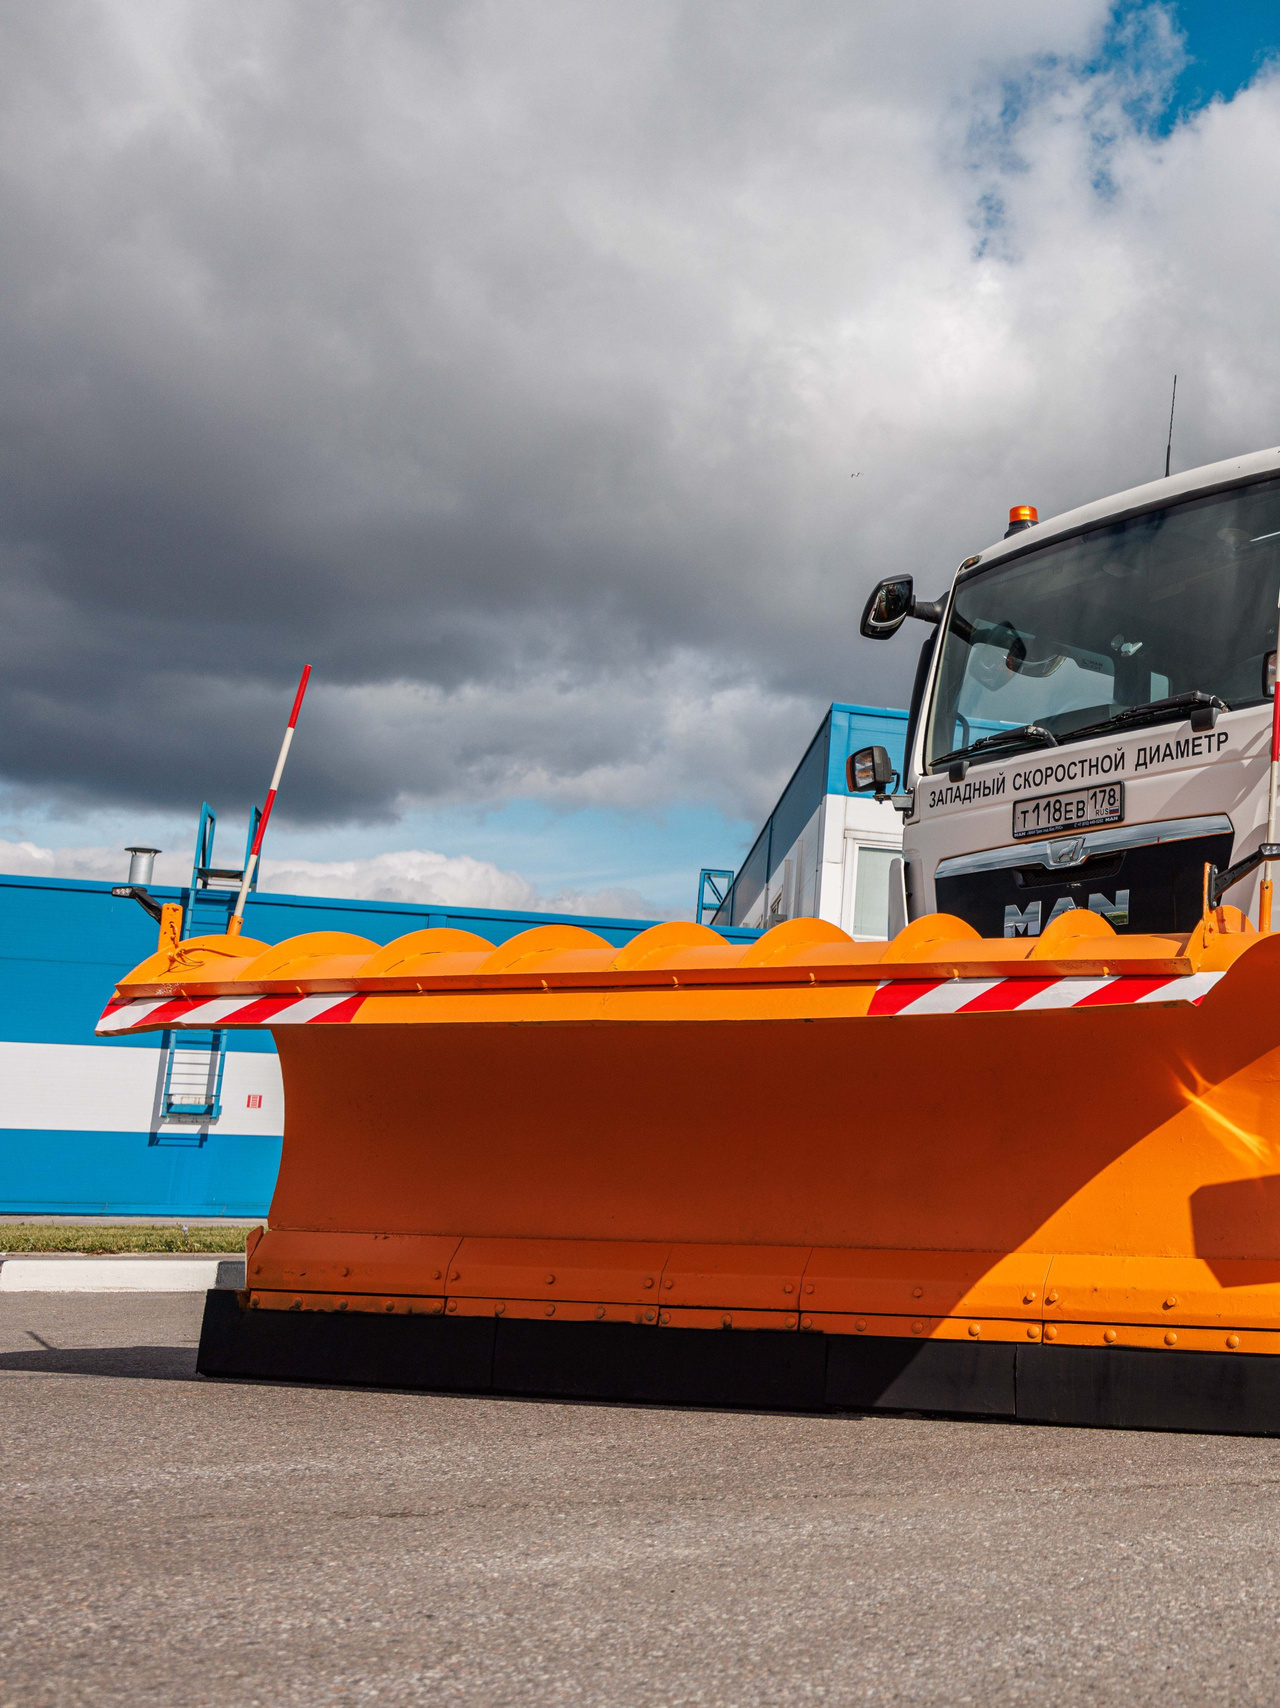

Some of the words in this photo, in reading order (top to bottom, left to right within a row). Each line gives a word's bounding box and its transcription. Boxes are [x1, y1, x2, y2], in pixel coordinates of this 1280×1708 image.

[929, 772, 1006, 808] ЗАПАДНЫЙ
[1012, 747, 1125, 791] СКОРОСТНОЙ
[1135, 731, 1229, 767] ДИАМЕТР
[1090, 788, 1116, 809] 178
[1095, 808, 1109, 816] RUS
